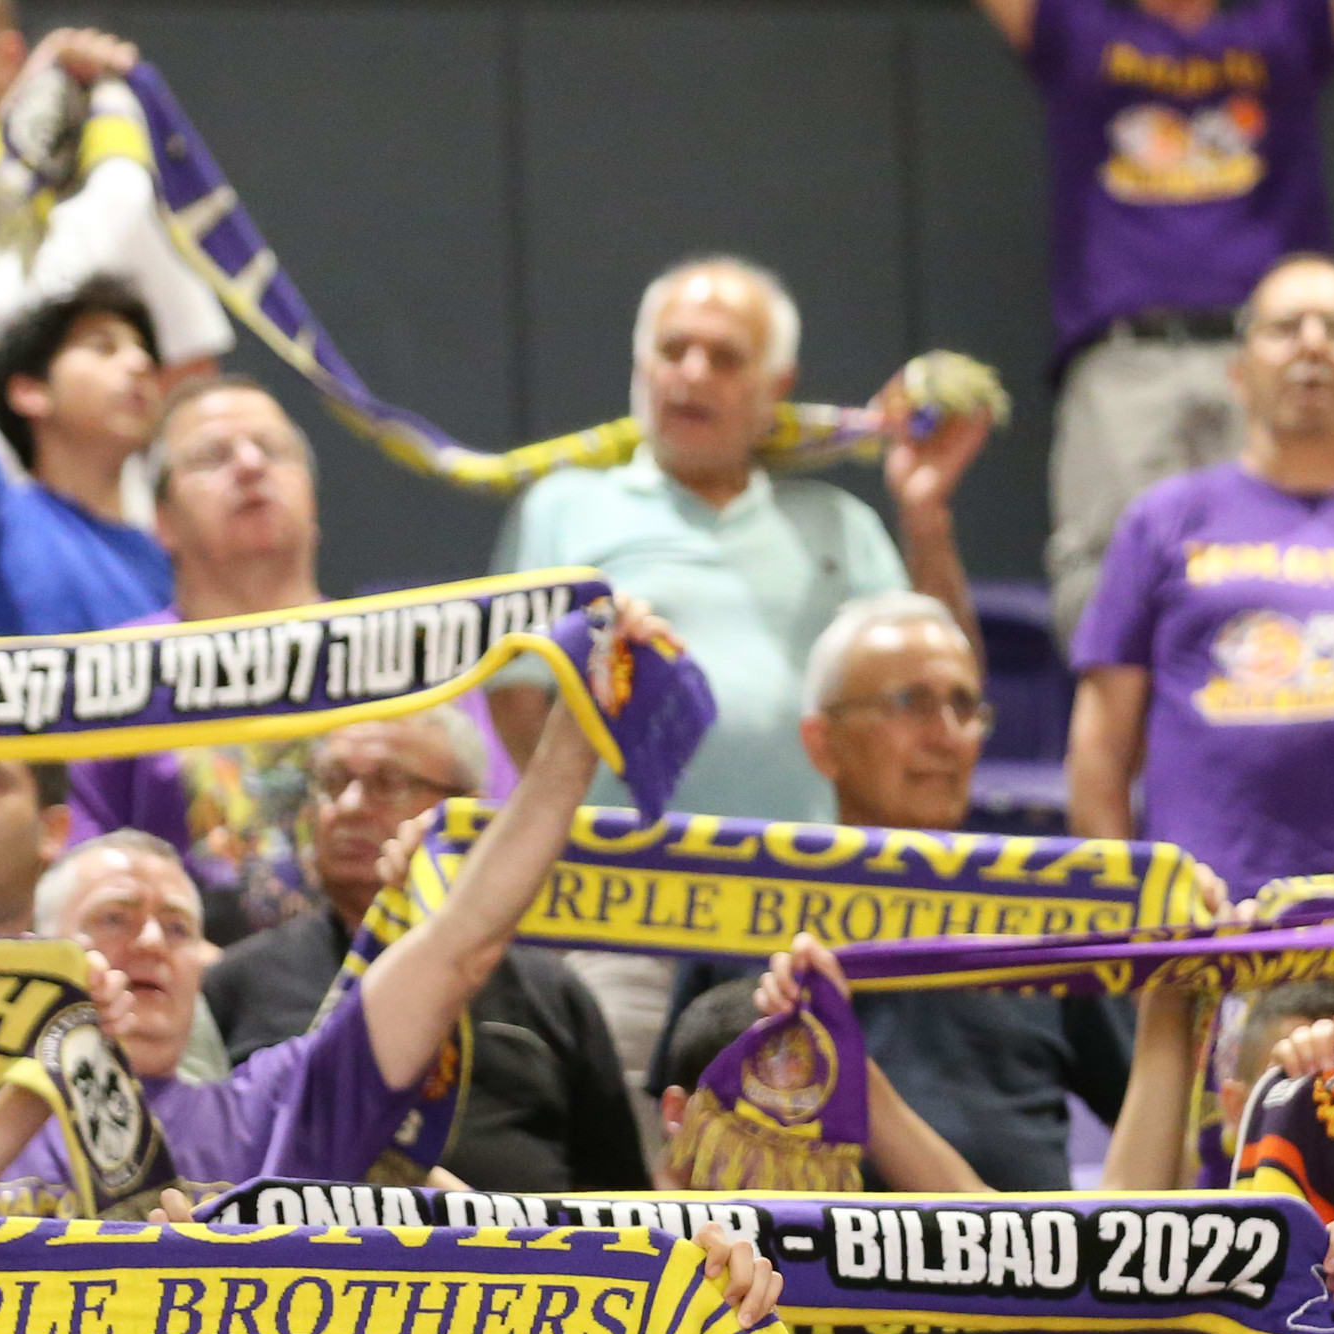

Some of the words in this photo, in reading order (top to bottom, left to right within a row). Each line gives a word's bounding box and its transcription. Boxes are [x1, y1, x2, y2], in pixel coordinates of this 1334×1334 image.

[71, 639, 151, 722] עם
[160, 621, 323, 711] לעצמי
[327, 603, 482, 699] מרשה
[544, 868, 720, 934] RPLE
[747, 883, 1117, 942] BROTHERS
[832, 1206, 1078, 1291] BILBAO
[1097, 1209, 1283, 1298] 2022
